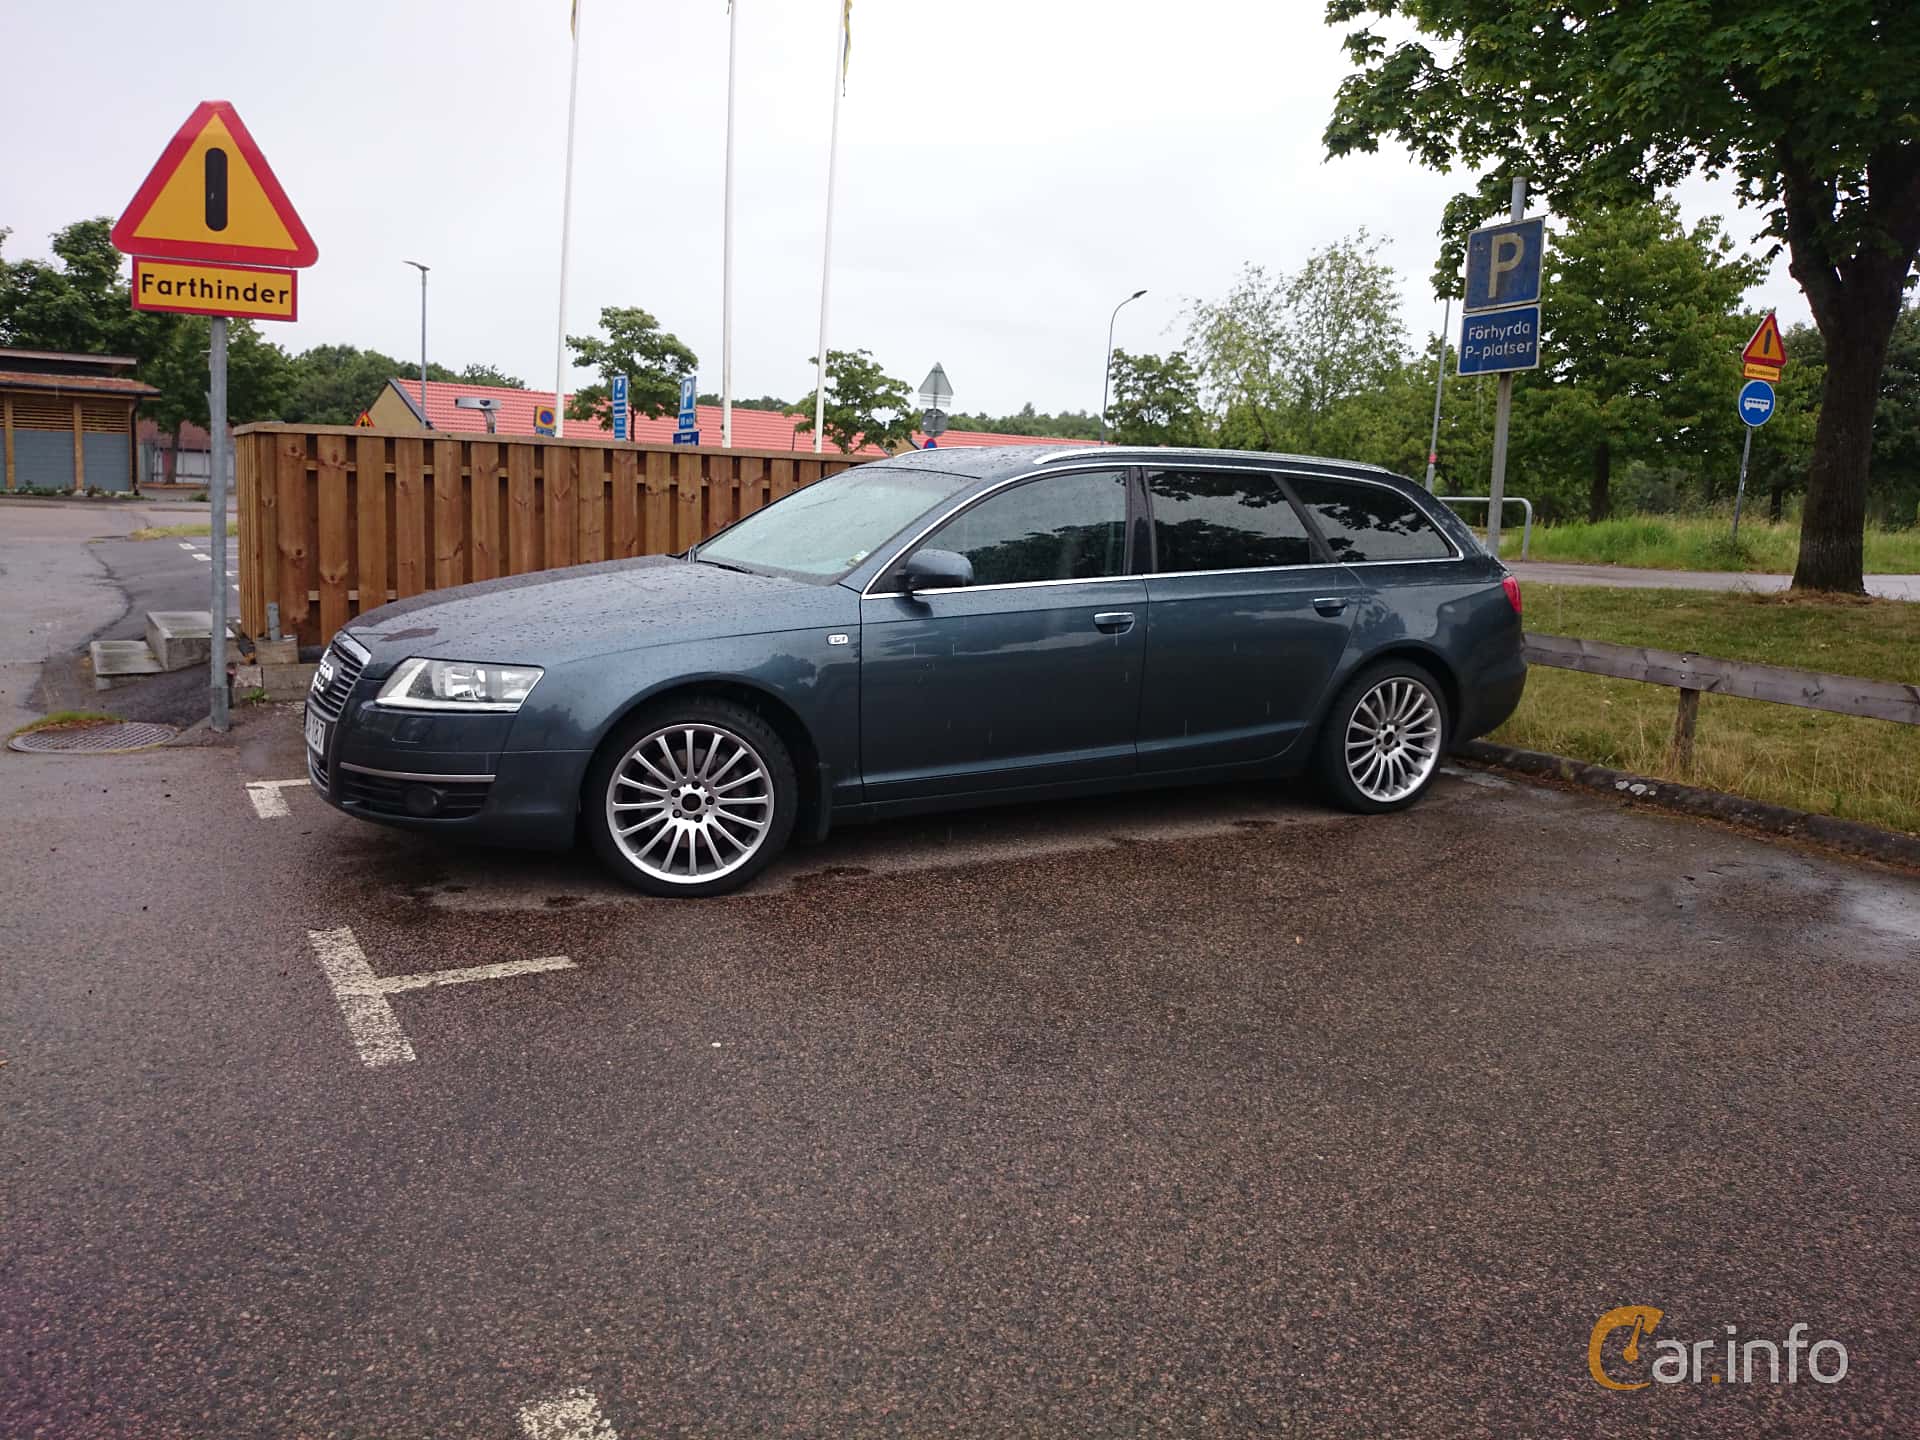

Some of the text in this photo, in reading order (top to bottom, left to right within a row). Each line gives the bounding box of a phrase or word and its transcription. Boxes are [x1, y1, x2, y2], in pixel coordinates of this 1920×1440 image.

[1488, 232, 1524, 298] P
[141, 273, 289, 304] Farthinder
[1468, 321, 1530, 341] Förhyrda
[1465, 341, 1533, 360] P-platser
[684, 381, 692, 409] P
